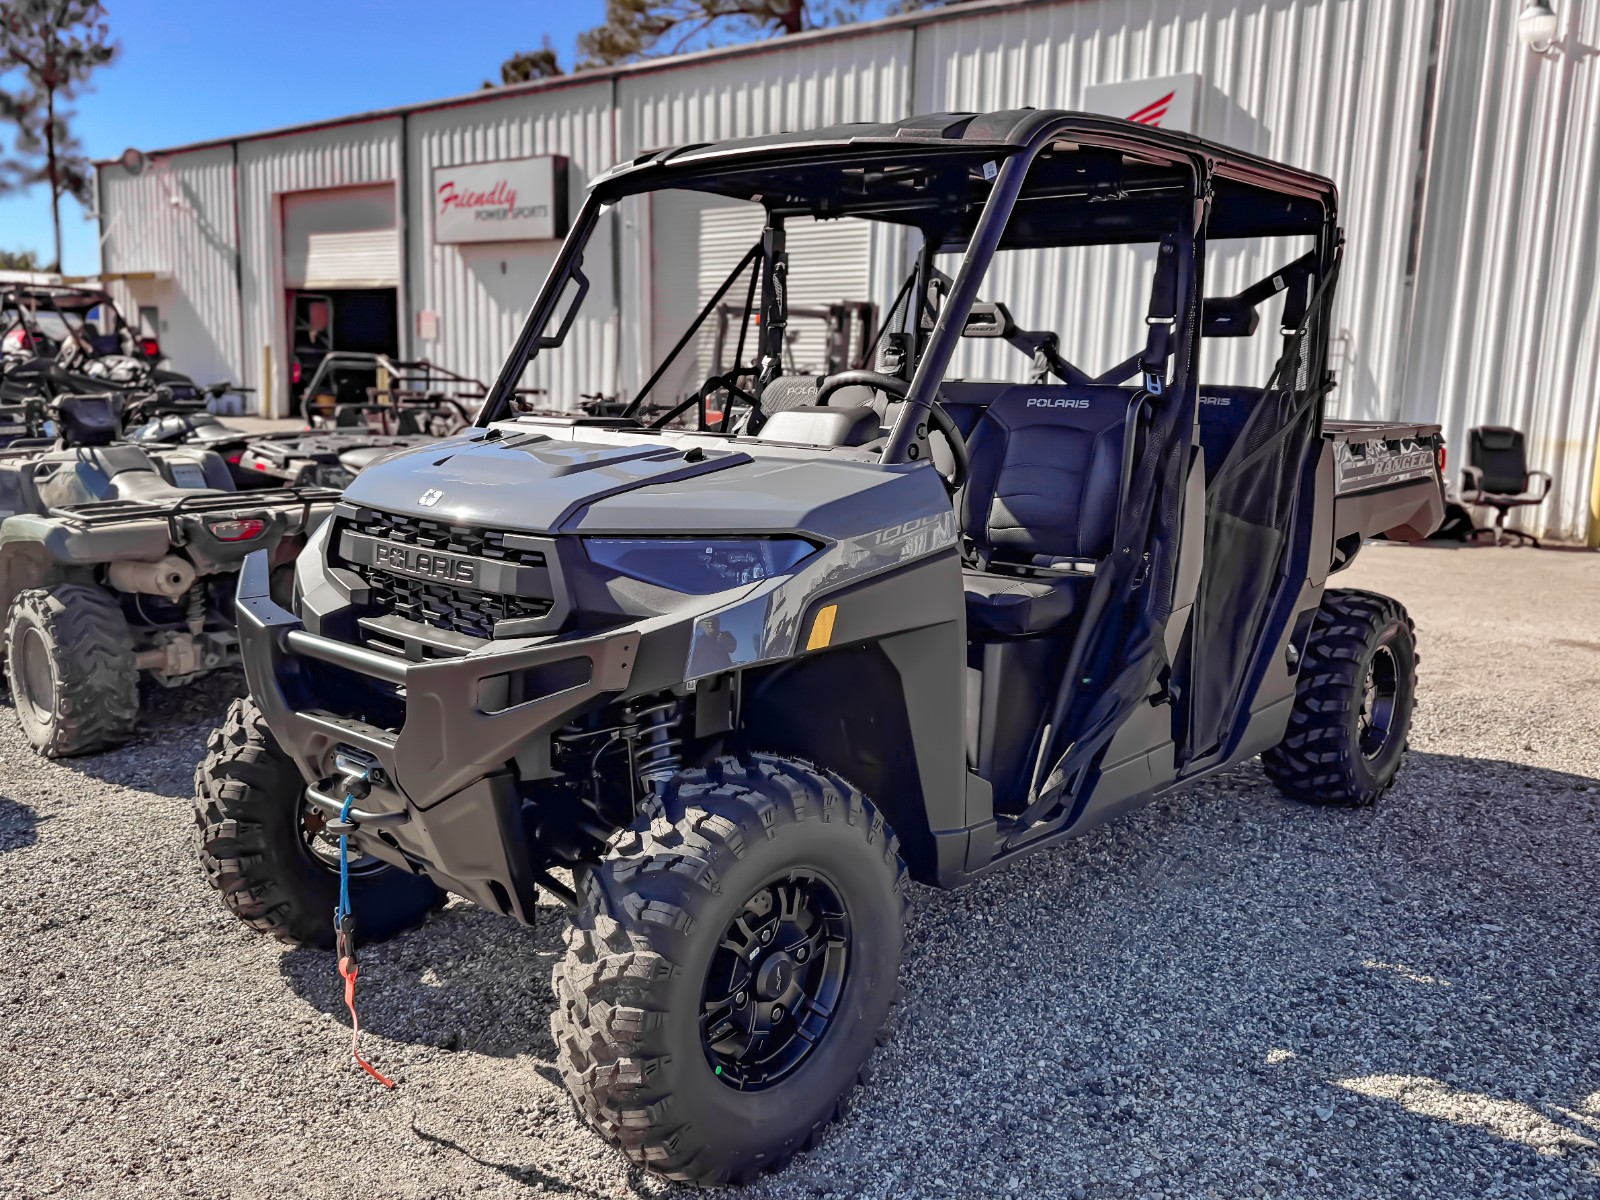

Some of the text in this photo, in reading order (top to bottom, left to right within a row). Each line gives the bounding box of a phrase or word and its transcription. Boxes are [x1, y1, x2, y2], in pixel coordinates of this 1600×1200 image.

[438, 179, 517, 215] Friendly
[475, 204, 548, 222] POWER SPORTS
[786, 386, 819, 396] POLA
[1026, 398, 1090, 409] POLARIS
[1199, 396, 1231, 406] ARIS
[1372, 452, 1428, 476] RANGER
[376, 543, 475, 584] POLARIS
